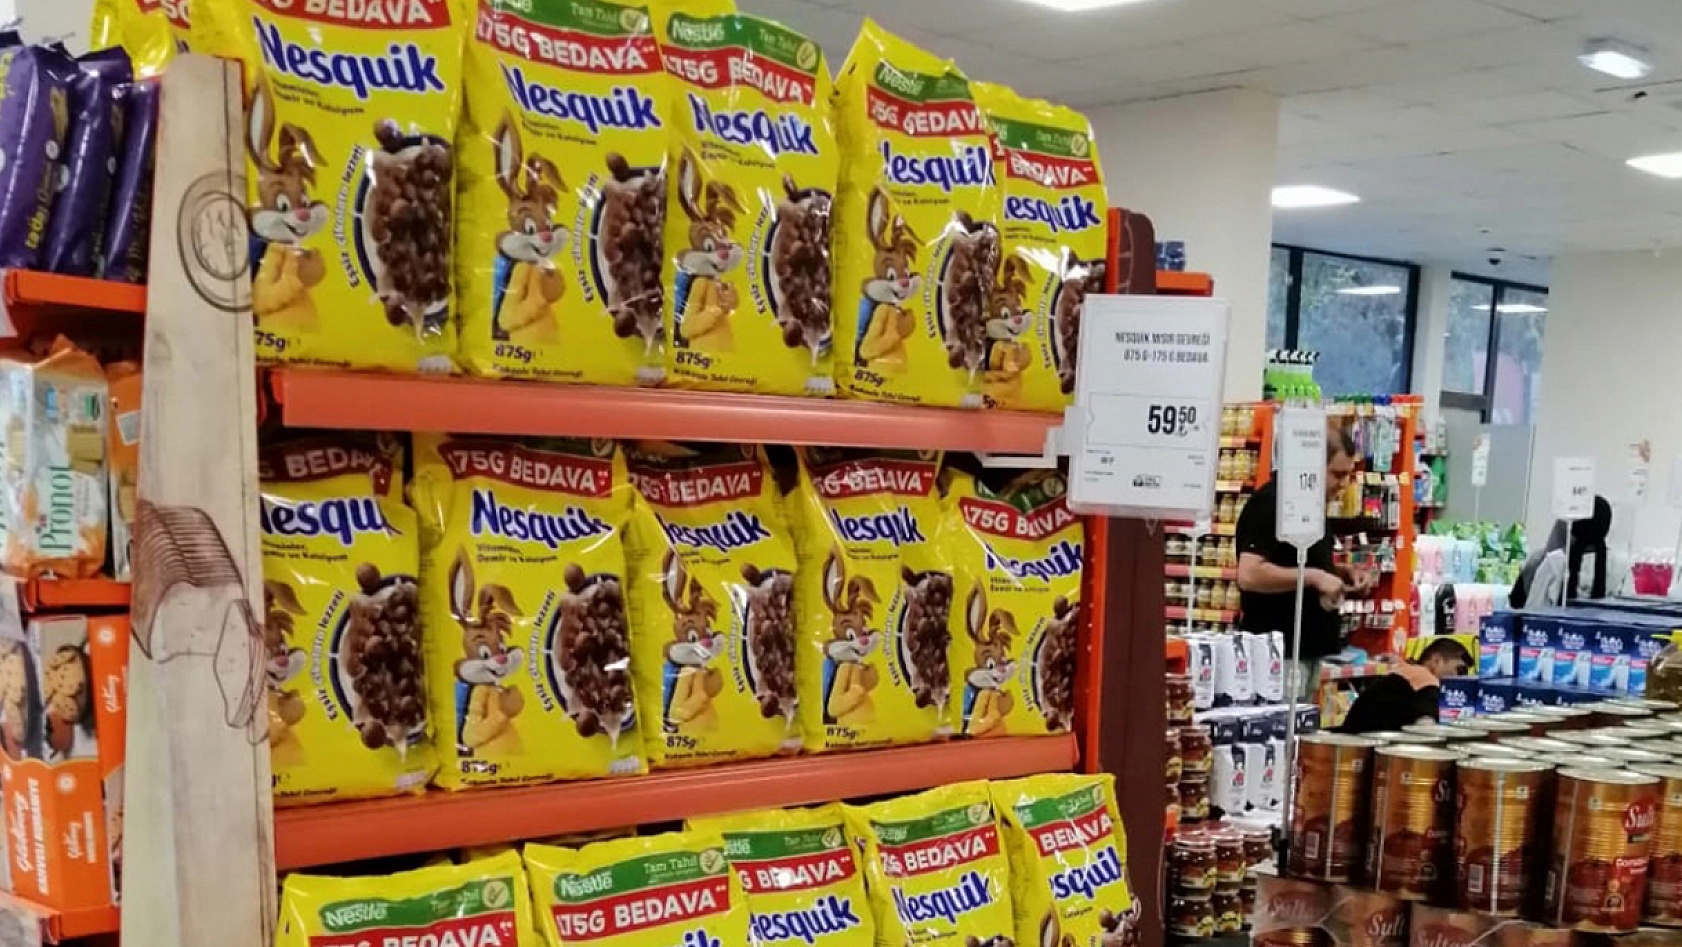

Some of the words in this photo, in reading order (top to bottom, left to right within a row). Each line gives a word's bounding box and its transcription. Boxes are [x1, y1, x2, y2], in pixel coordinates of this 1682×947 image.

[253, 16, 445, 98] Nesquik
[537, 35, 648, 70] BEDAVA
[501, 63, 661, 133] Nesquik
[1004, 195, 1101, 233] esquik
[676, 351, 711, 369] 875g
[1148, 405, 1176, 434] 59
[510, 456, 597, 493] BEDAVA
[473, 489, 613, 549] Nesquik
[666, 736, 696, 750] 875g
[903, 836, 987, 871] BEDAVA
[613, 888, 717, 928] BEDAVA
